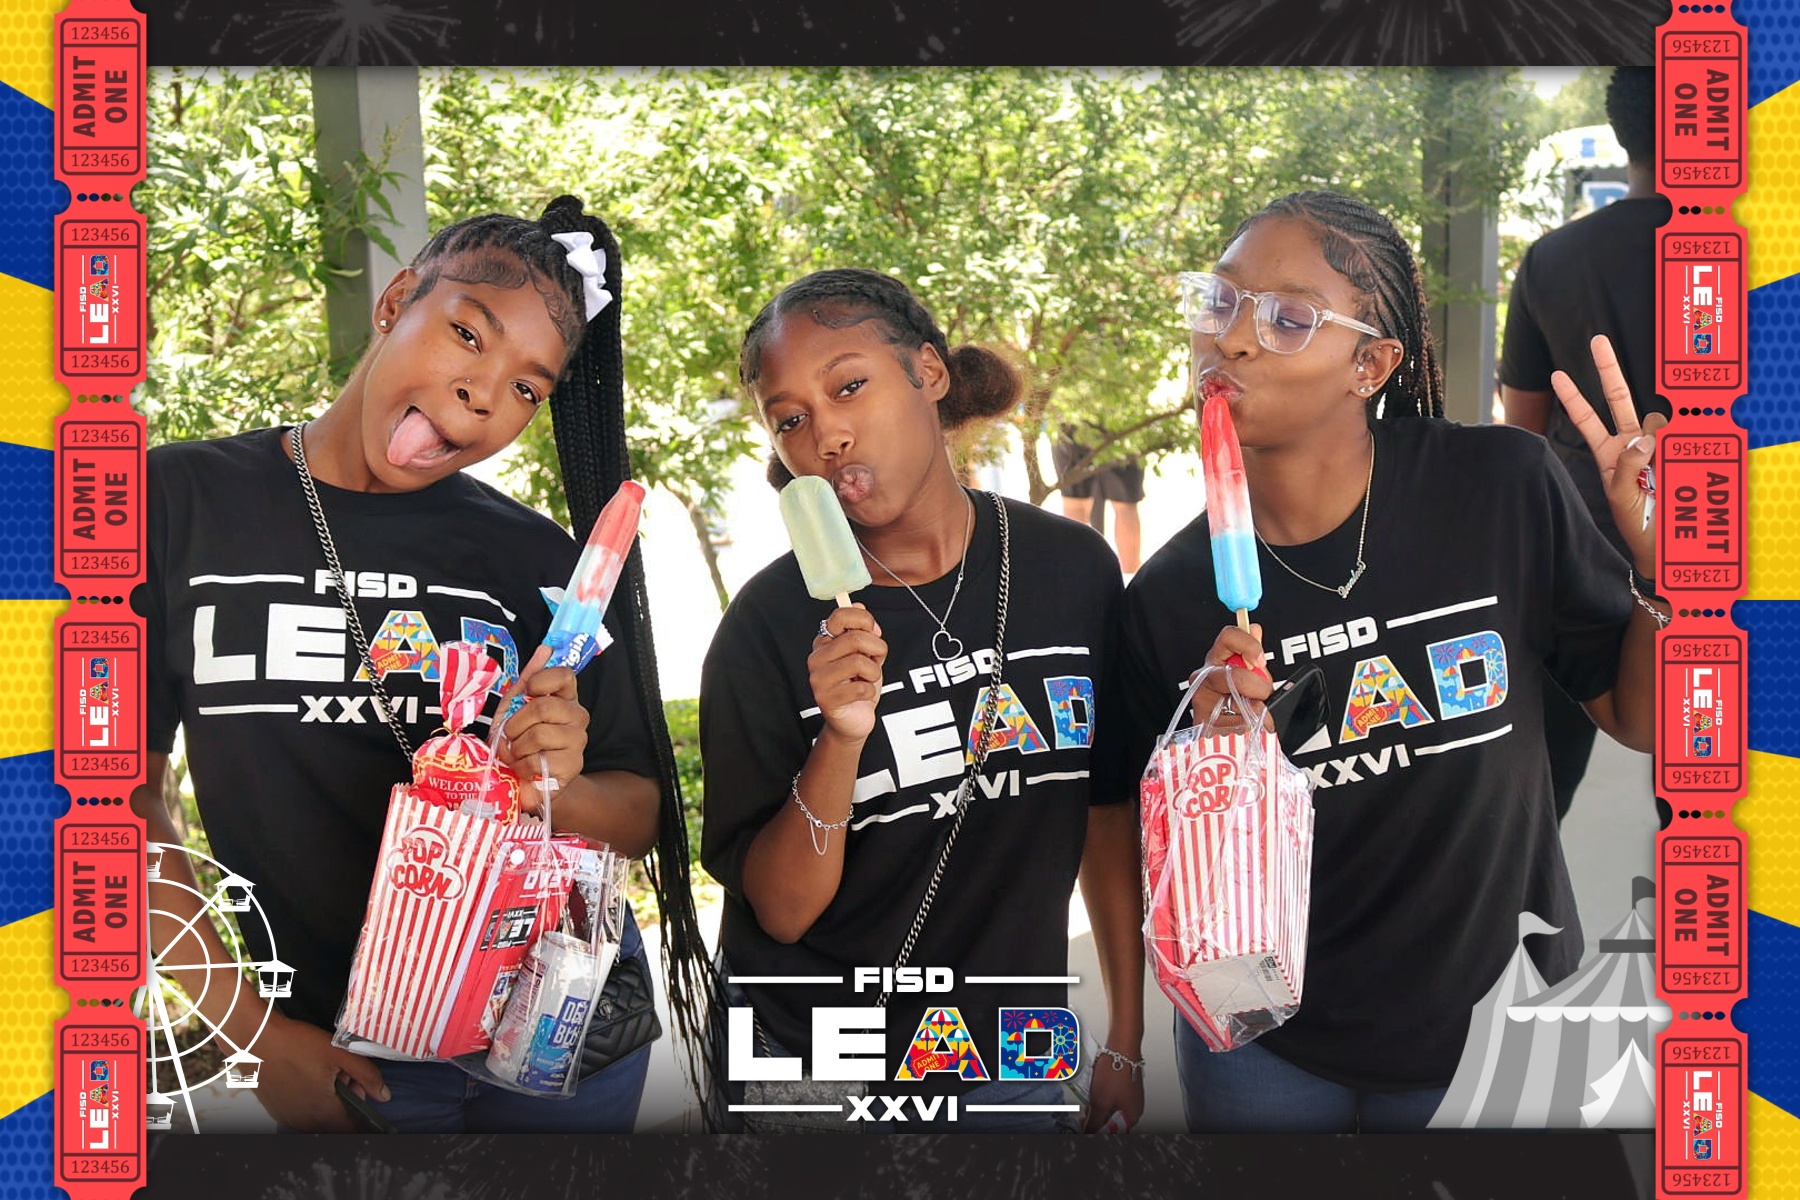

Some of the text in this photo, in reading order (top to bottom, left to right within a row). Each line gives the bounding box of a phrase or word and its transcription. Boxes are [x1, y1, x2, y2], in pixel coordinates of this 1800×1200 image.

[314, 570, 418, 599] FISD
[192, 603, 520, 696] LEAD
[1281, 616, 1379, 665] FISD
[909, 648, 1001, 693] FISD
[300, 695, 418, 724] XXVI
[1187, 762, 1232, 793] POP
[1304, 743, 1411, 790] XXVI
[445, 792, 457, 800] TO
[402, 837, 443, 866] POP
[392, 864, 452, 900] CORN
